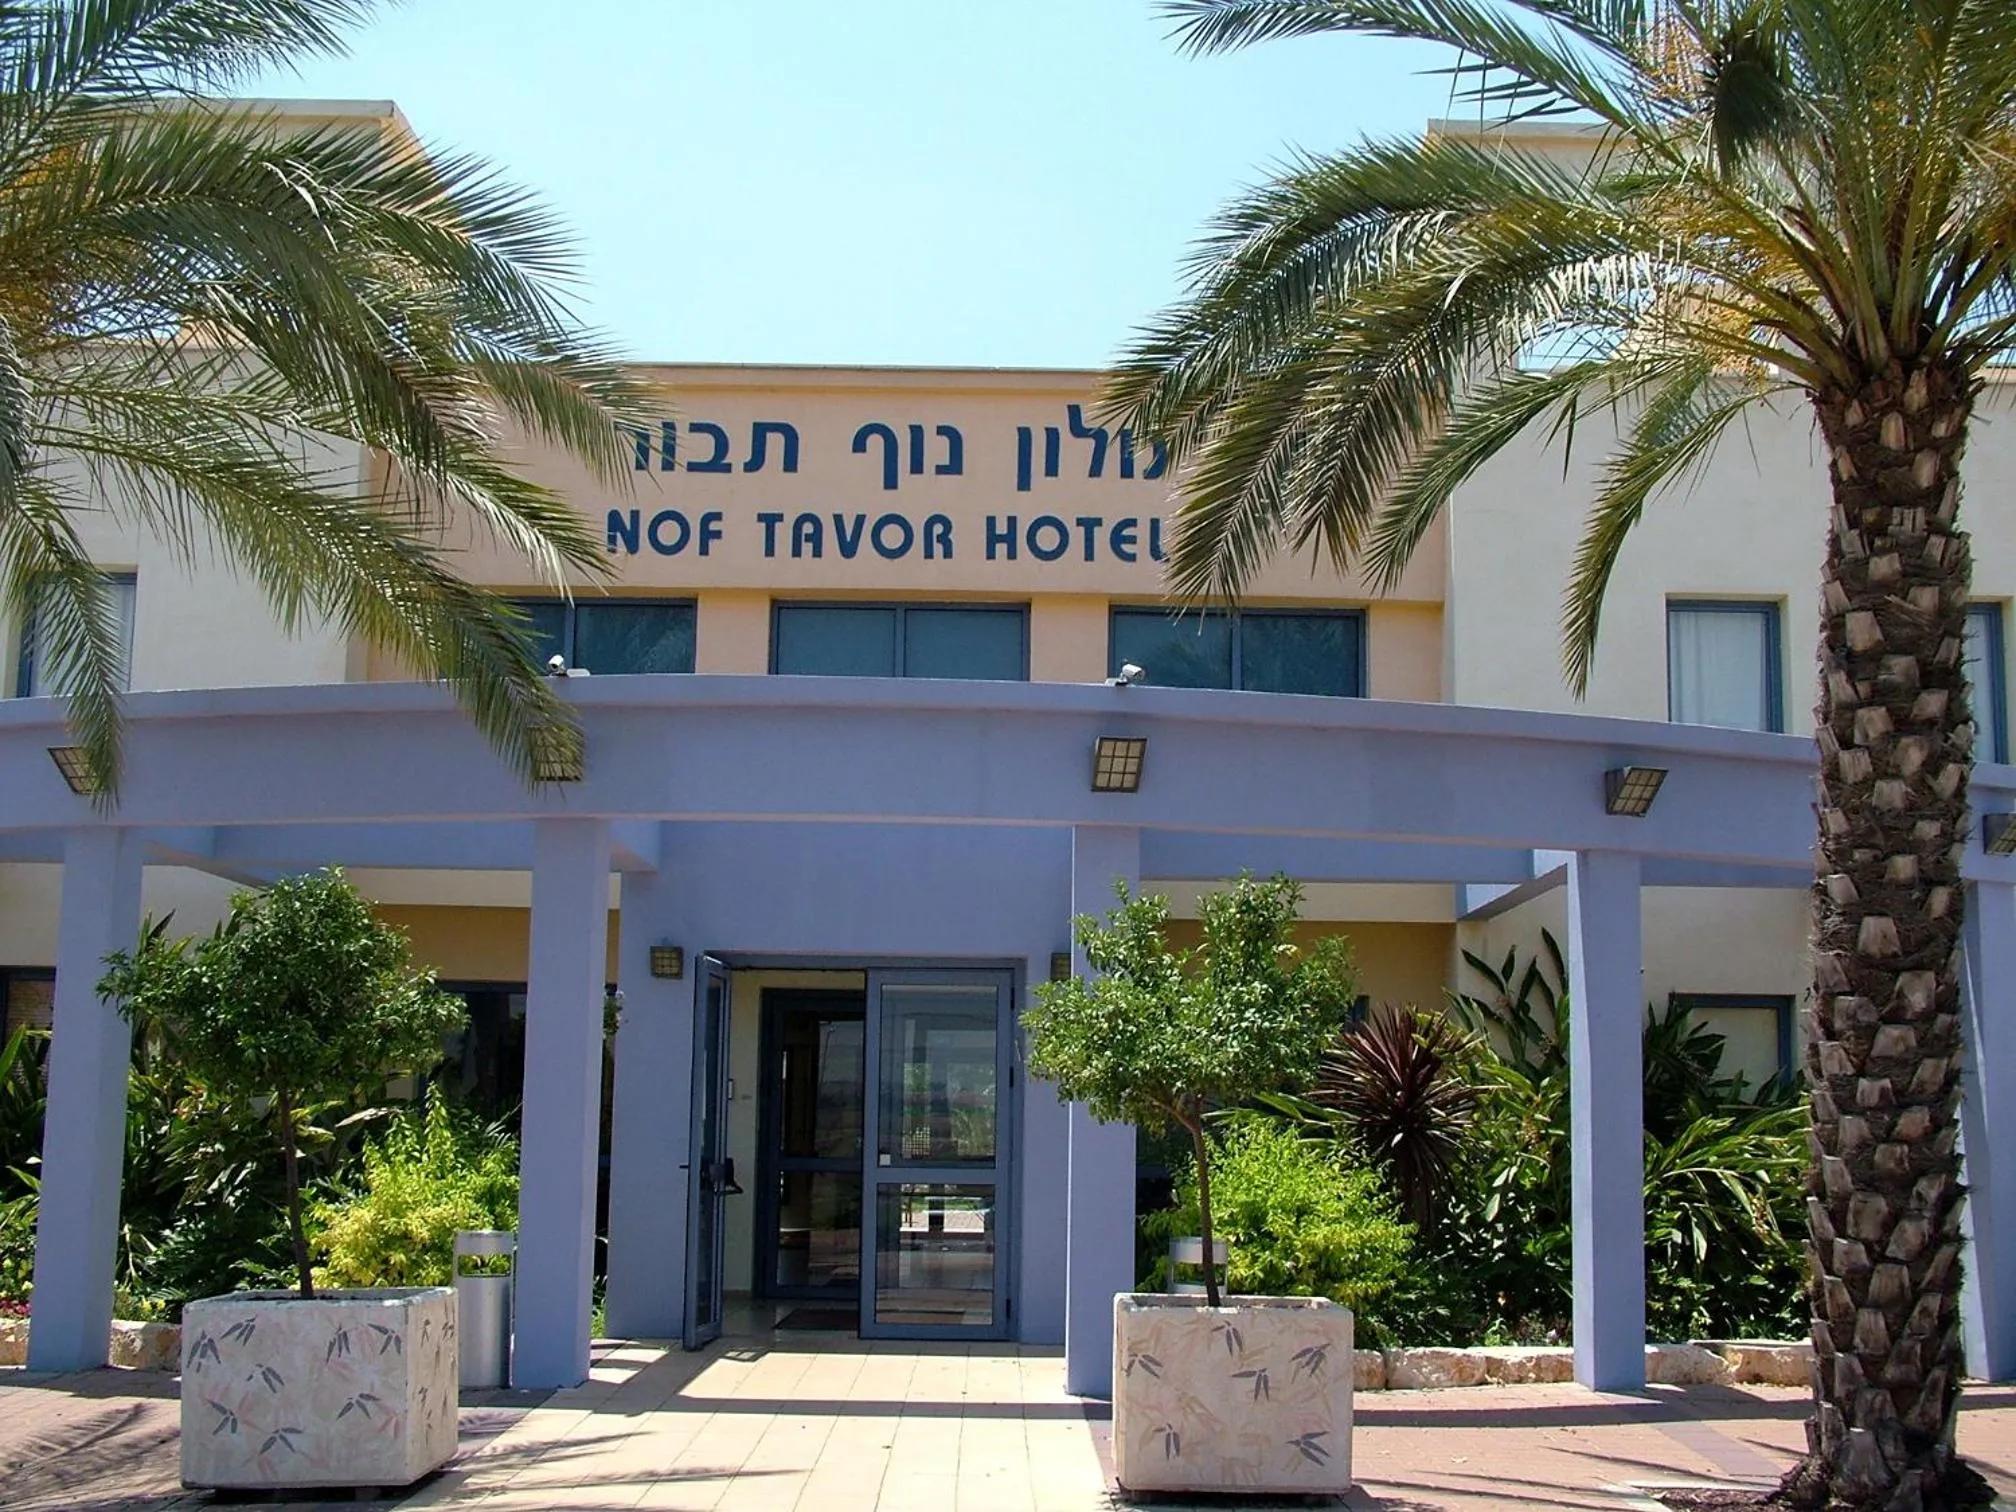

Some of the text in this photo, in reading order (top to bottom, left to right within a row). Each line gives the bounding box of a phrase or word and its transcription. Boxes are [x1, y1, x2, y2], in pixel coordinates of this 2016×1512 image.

[612, 421, 799, 473] תבור
[852, 422, 963, 490] נוף
[606, 508, 1171, 562] NOF TAVOR HOTEL
